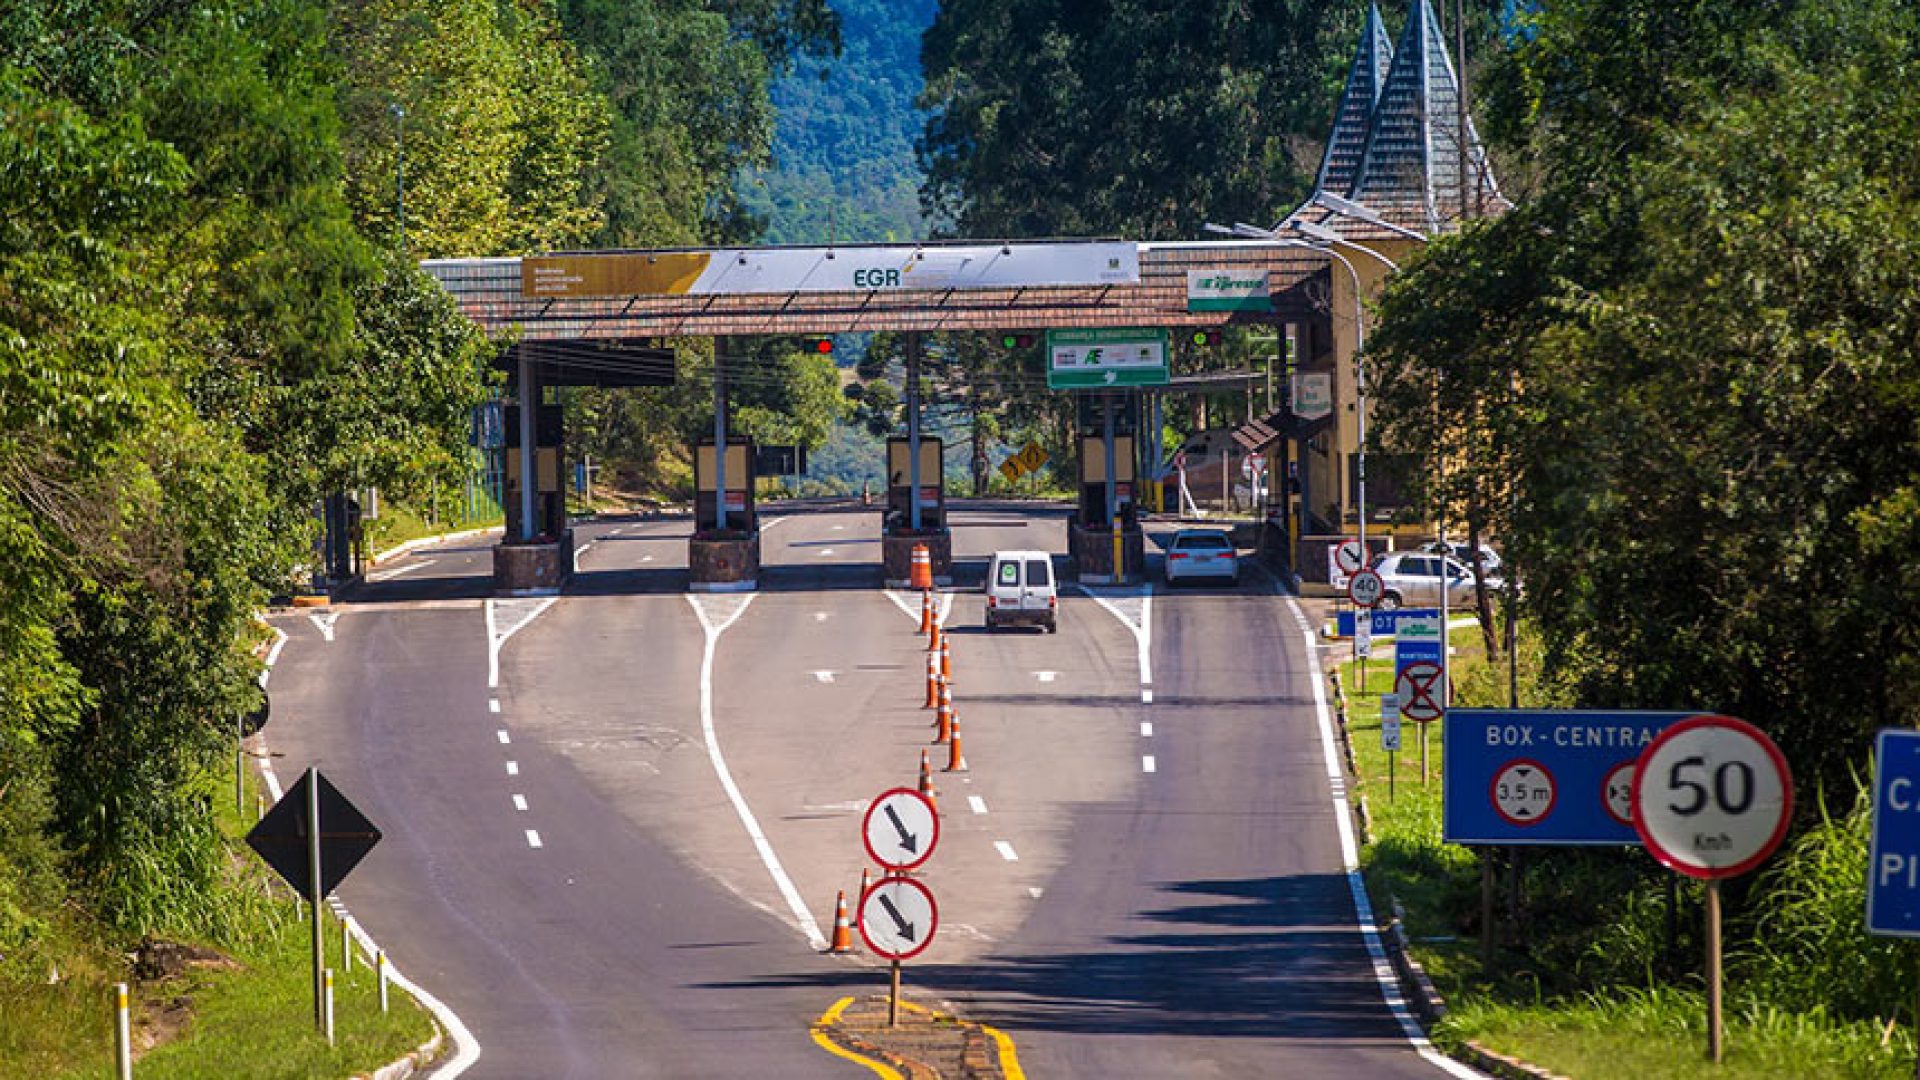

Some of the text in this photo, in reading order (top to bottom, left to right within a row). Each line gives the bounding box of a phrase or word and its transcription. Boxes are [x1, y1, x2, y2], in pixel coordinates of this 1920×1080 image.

[854, 269, 900, 286] EGR
[1355, 578, 1378, 592] 40
[1668, 756, 1755, 816] 50
